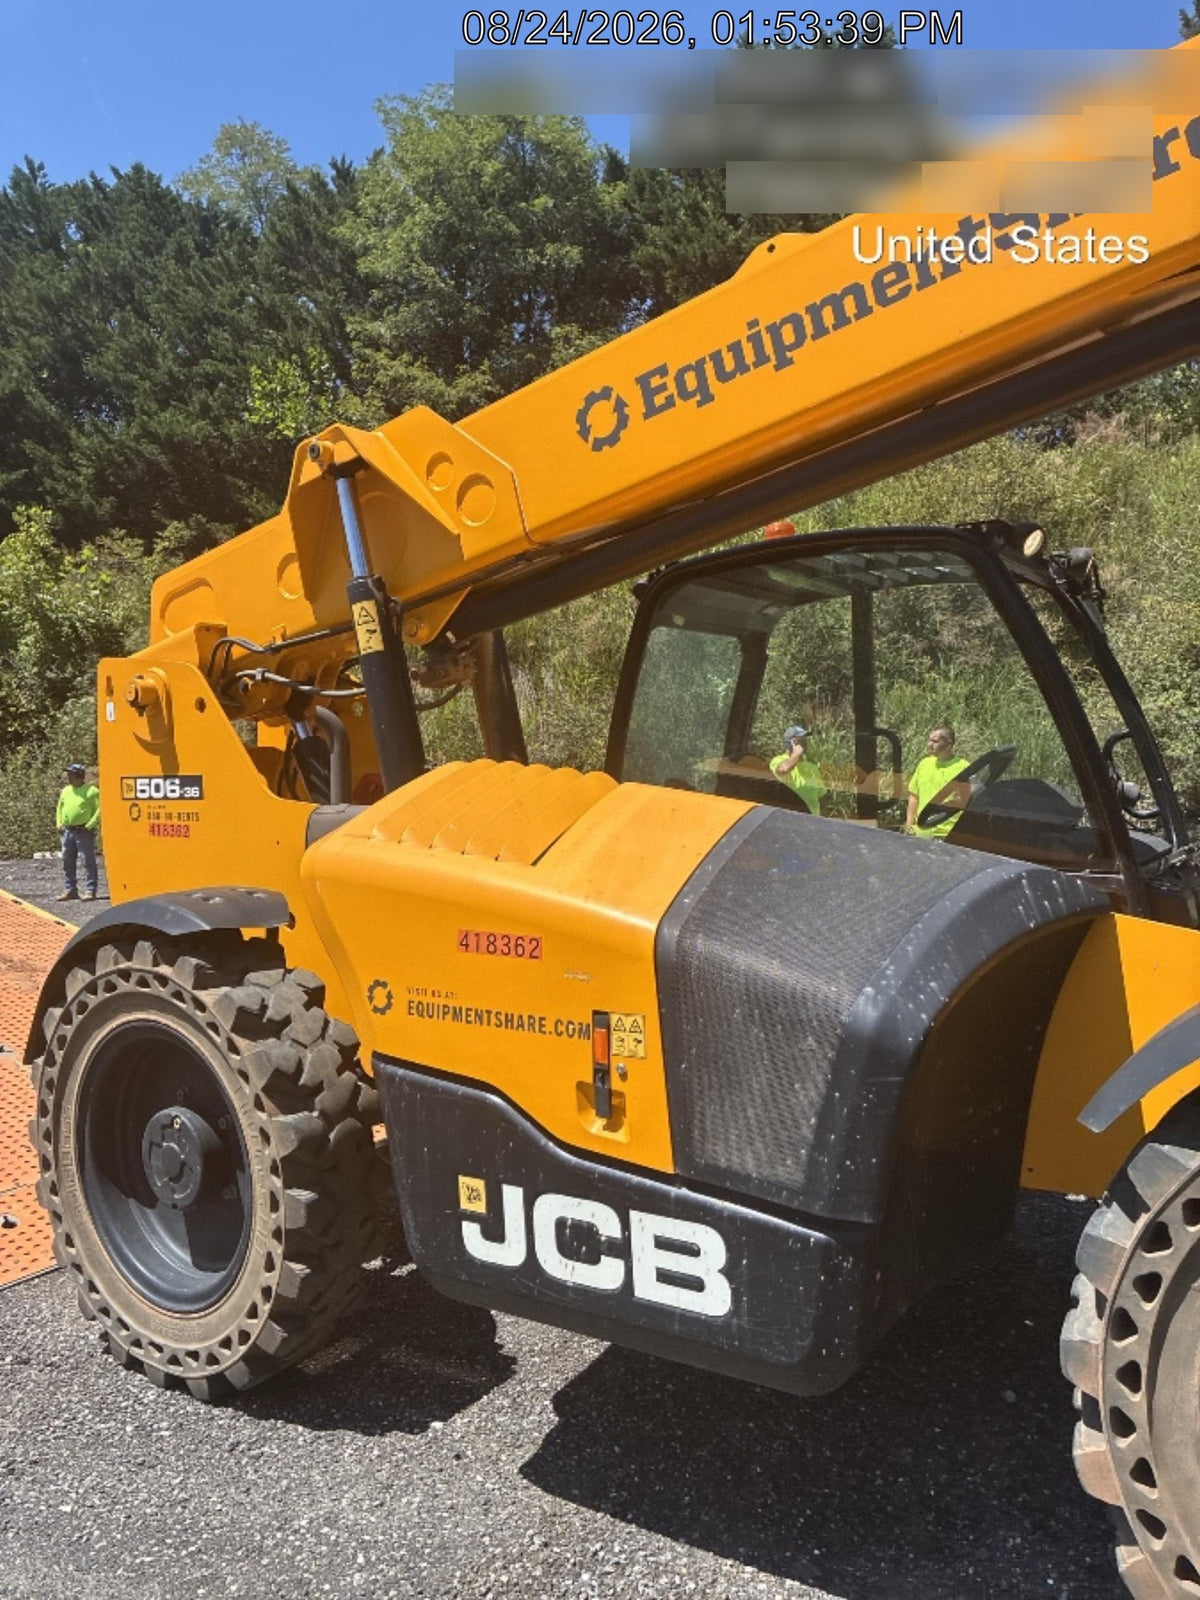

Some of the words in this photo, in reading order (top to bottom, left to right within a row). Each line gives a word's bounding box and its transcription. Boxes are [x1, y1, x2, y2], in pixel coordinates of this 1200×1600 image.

[136, 777, 200, 799] 506-36
[458, 930, 541, 960] 418362
[407, 999, 592, 1041] EQUIPMENTSHARE.COM
[460, 1183, 732, 1317] JCB
